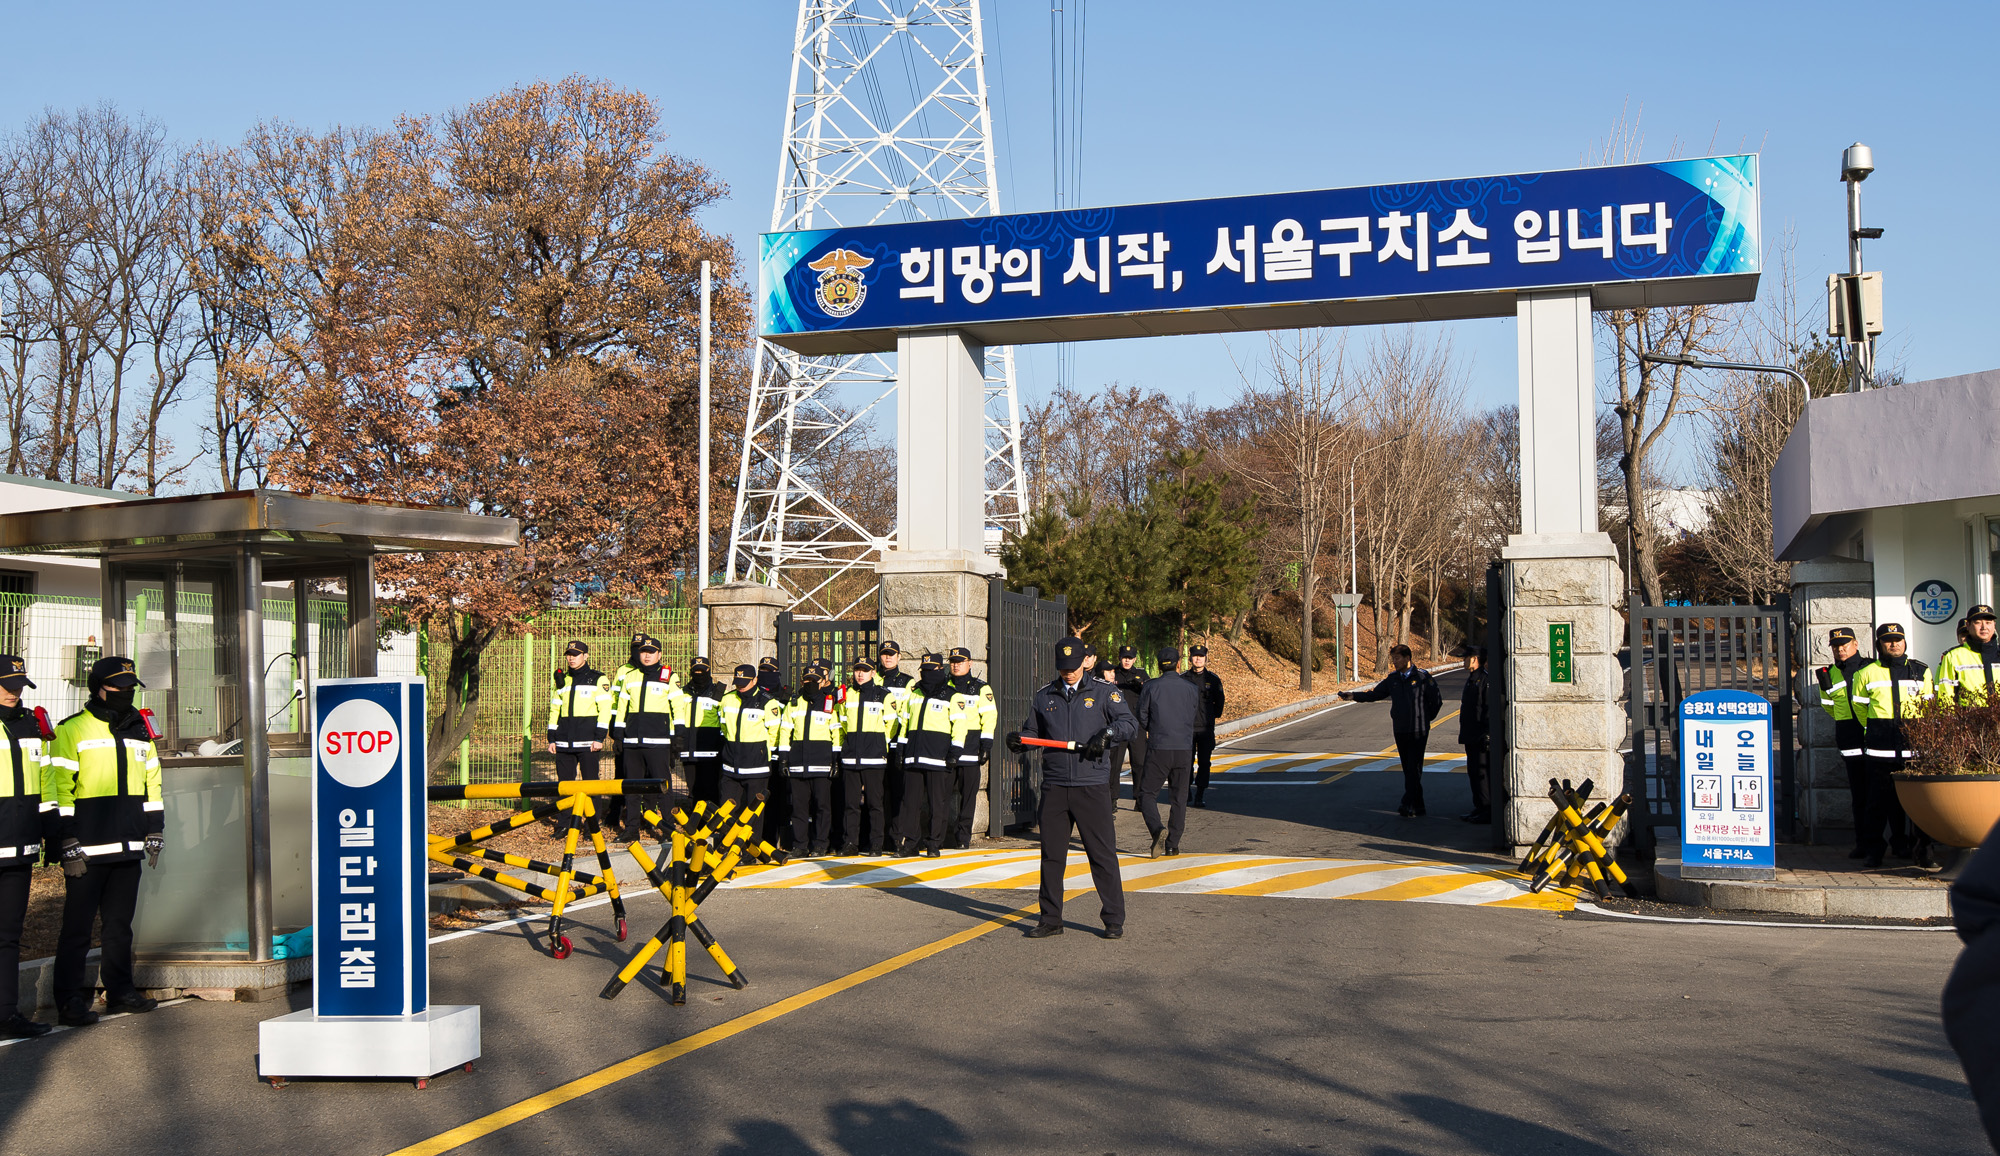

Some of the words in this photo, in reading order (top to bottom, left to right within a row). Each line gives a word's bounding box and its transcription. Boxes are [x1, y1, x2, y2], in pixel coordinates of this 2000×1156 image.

[900, 245, 1041, 304] 희망의
[1063, 231, 1183, 293] 시작,
[1206, 208, 1491, 284] 서울구치소
[1513, 201, 1673, 264] 입니다
[1917, 598, 1953, 611] 143
[1555, 627, 1566, 680] 서울구치소
[1684, 702, 1714, 715] 승용차
[1716, 702, 1768, 715] 선택요일제
[325, 730, 393, 755] STOP
[1695, 729, 1714, 771] 내일
[1737, 730, 1755, 772] 오늘
[1701, 793, 1713, 806] 화
[1742, 794, 1754, 807] 월
[1699, 812, 1715, 821] 요일
[1739, 813, 1755, 822] 요일
[1693, 824, 1729, 835] 선택차량
[1732, 825, 1749, 836] 쉬는
[1752, 825, 1762, 836] 날
[1702, 848, 1754, 860] 서울구치소
[338, 808, 378, 988] 일단멈춤
